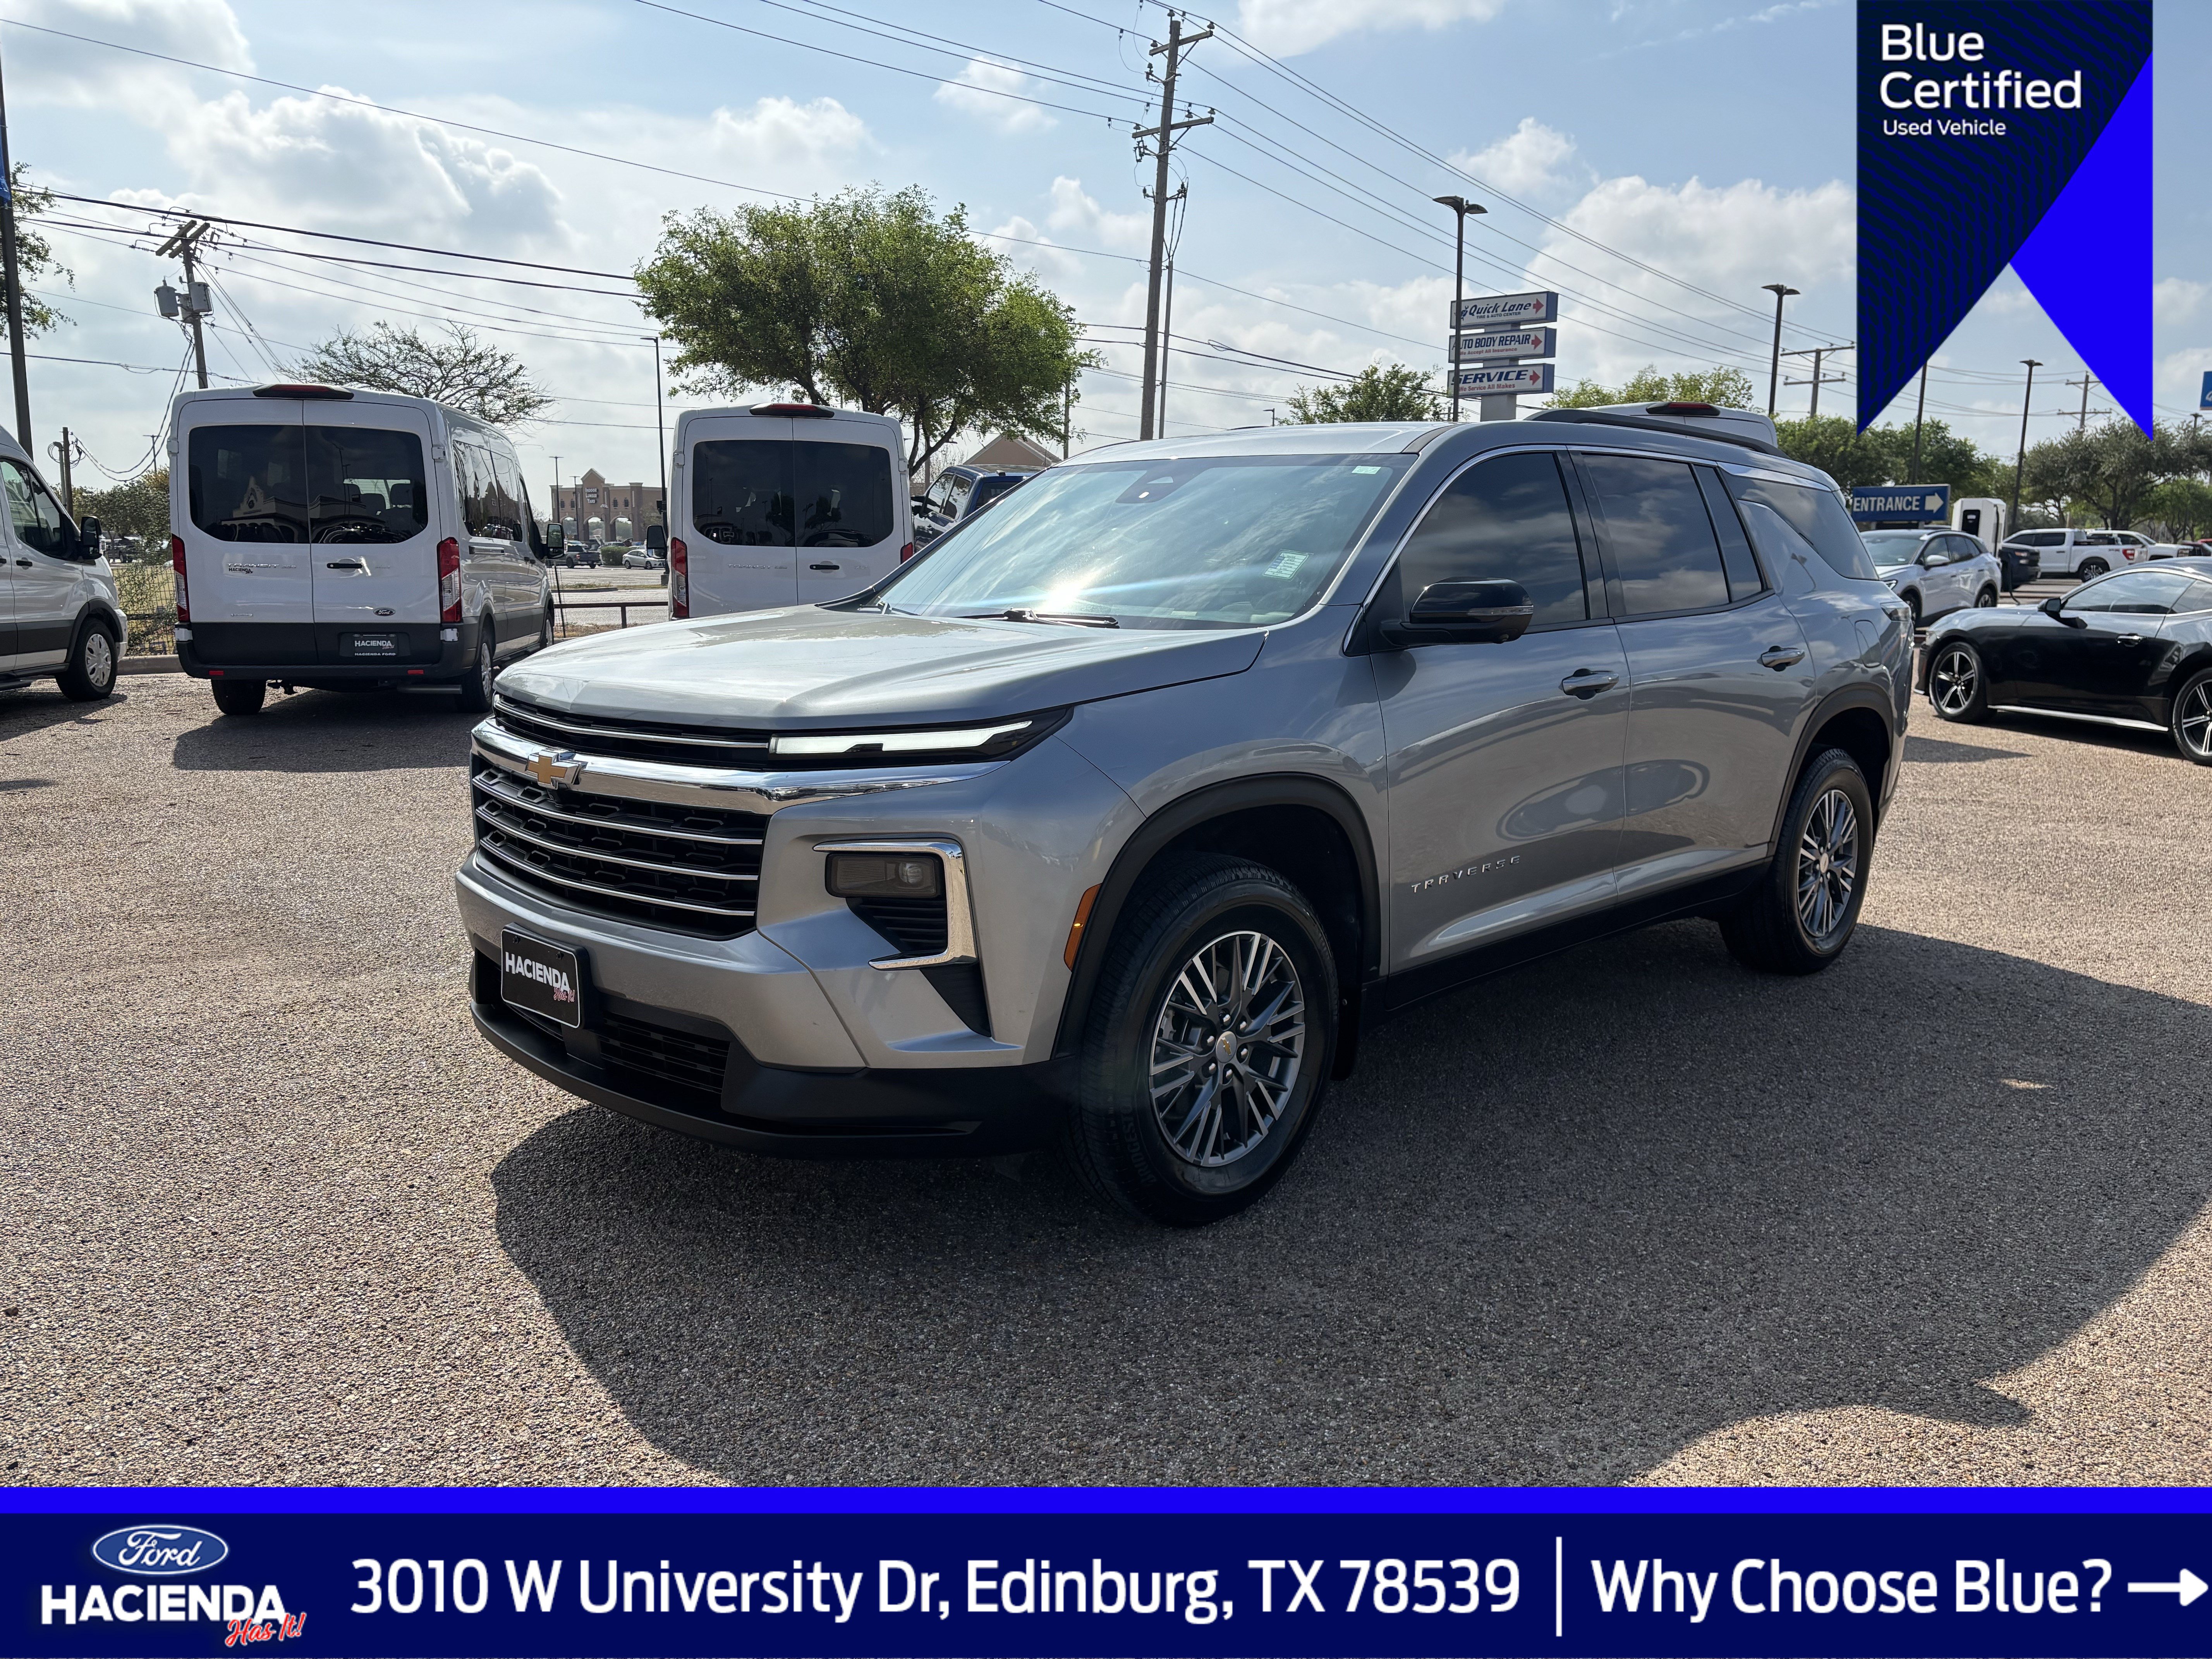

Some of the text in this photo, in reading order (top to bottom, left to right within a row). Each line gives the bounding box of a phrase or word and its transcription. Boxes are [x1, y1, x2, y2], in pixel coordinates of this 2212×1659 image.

[1469, 302, 1532, 316] Quick Lane
[1475, 336, 1498, 348] BODY
[1498, 334, 1531, 346] REPAIR
[1853, 496, 1921, 512] ENTRANCE
[1411, 855, 1520, 893] TRAVERSE
[505, 951, 571, 993] HACIENDA
